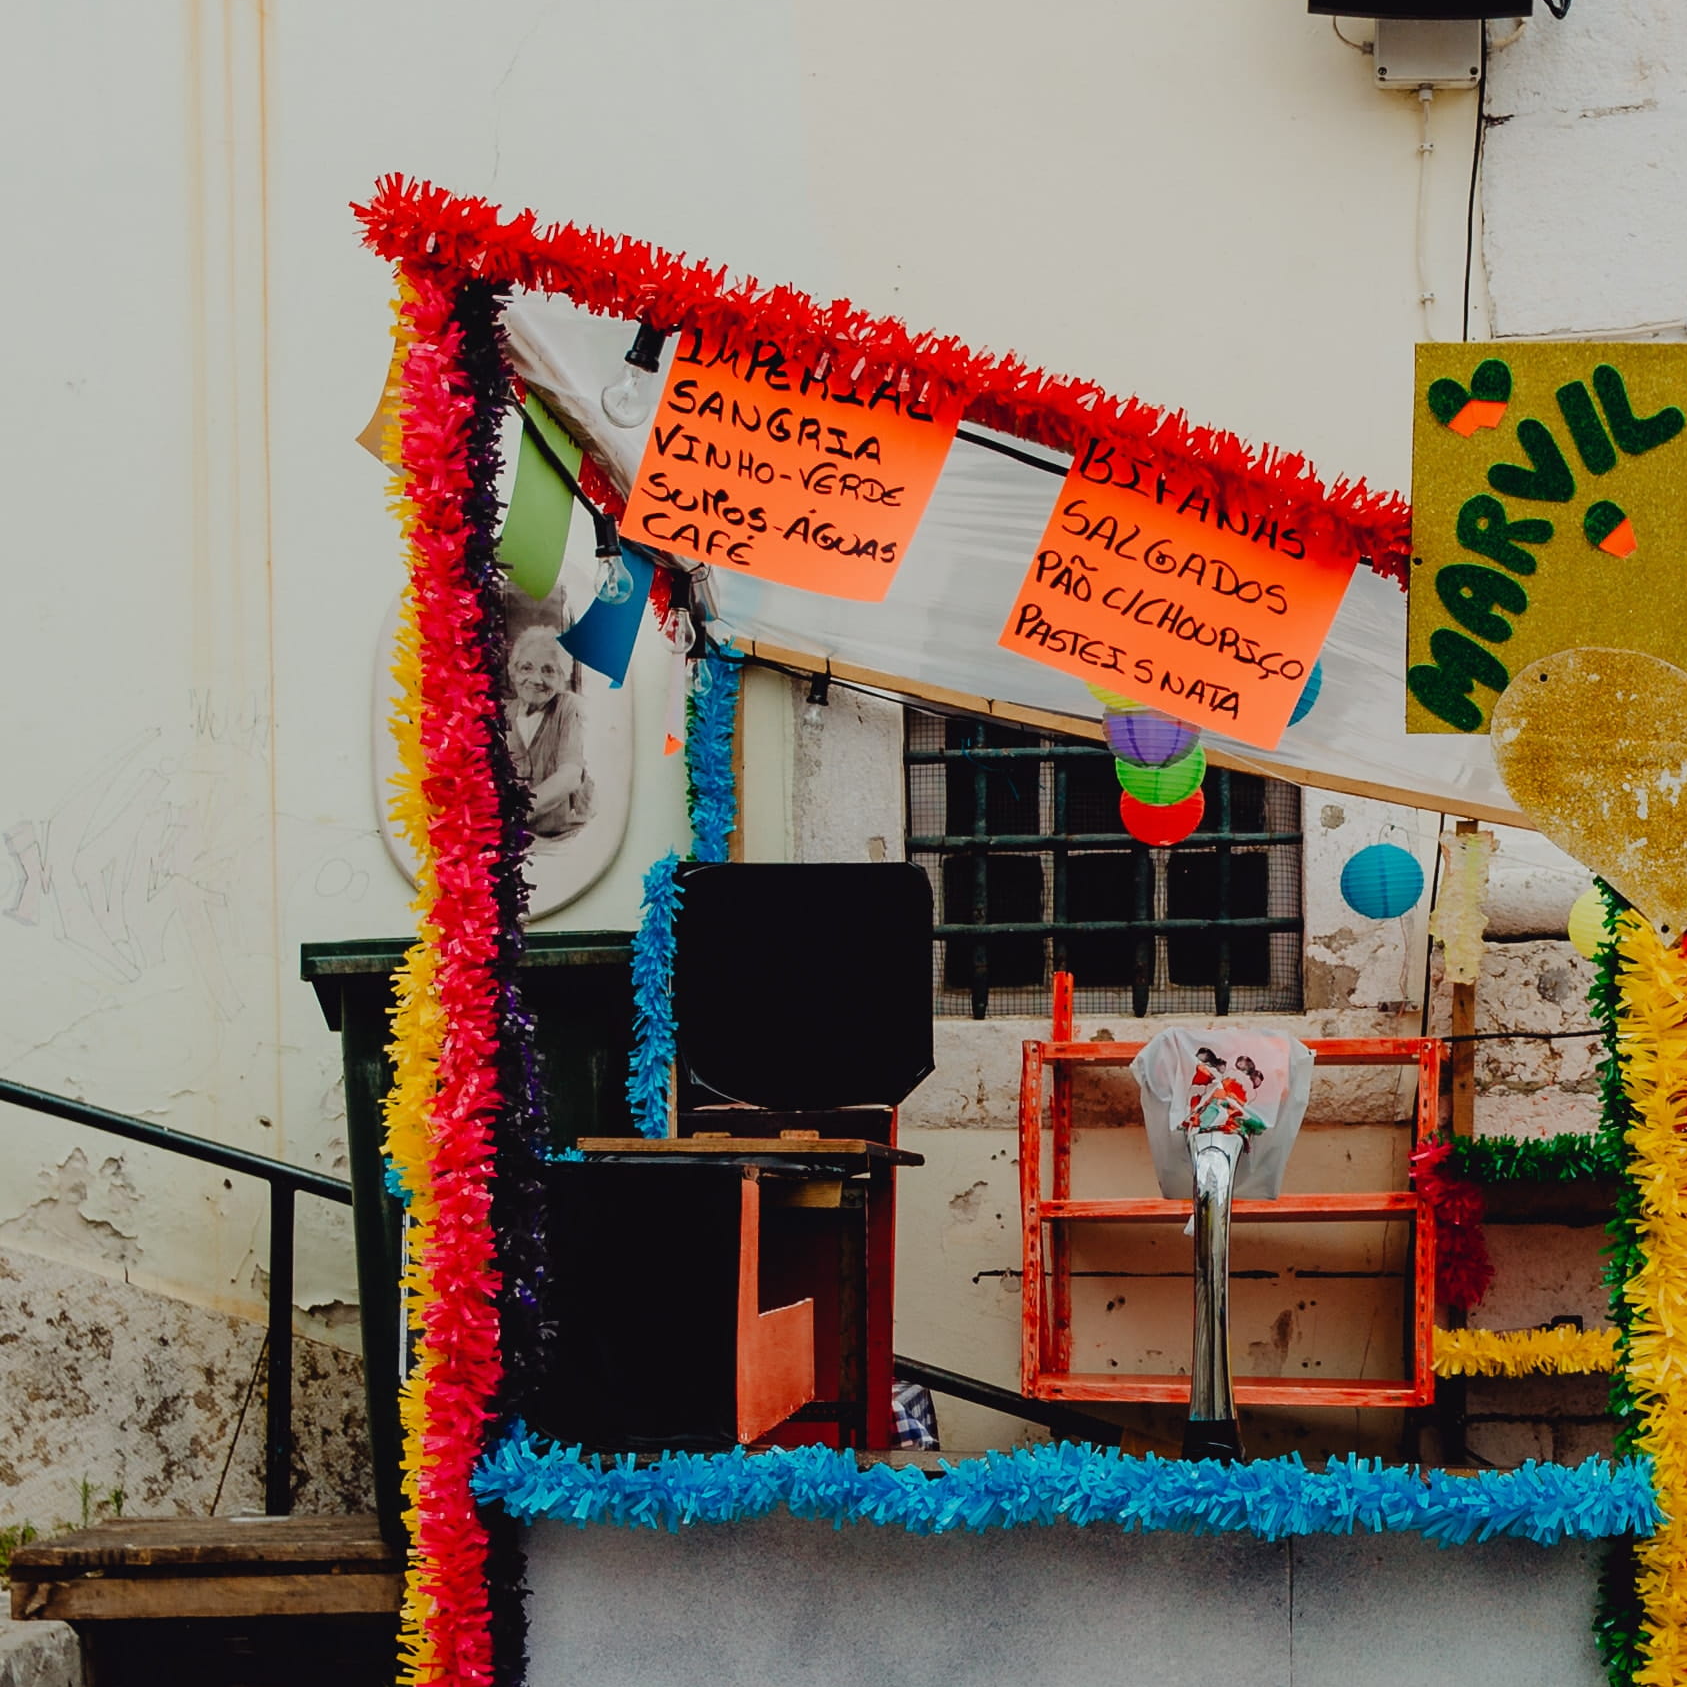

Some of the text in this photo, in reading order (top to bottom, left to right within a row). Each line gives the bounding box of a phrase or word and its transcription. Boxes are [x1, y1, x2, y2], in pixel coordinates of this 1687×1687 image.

[667, 379, 881, 465] SANGRIA
[1035, 550, 1098, 603] PÃO
[1061, 499, 1288, 615] SALGADOS
[1160, 670, 1240, 720] NATA
